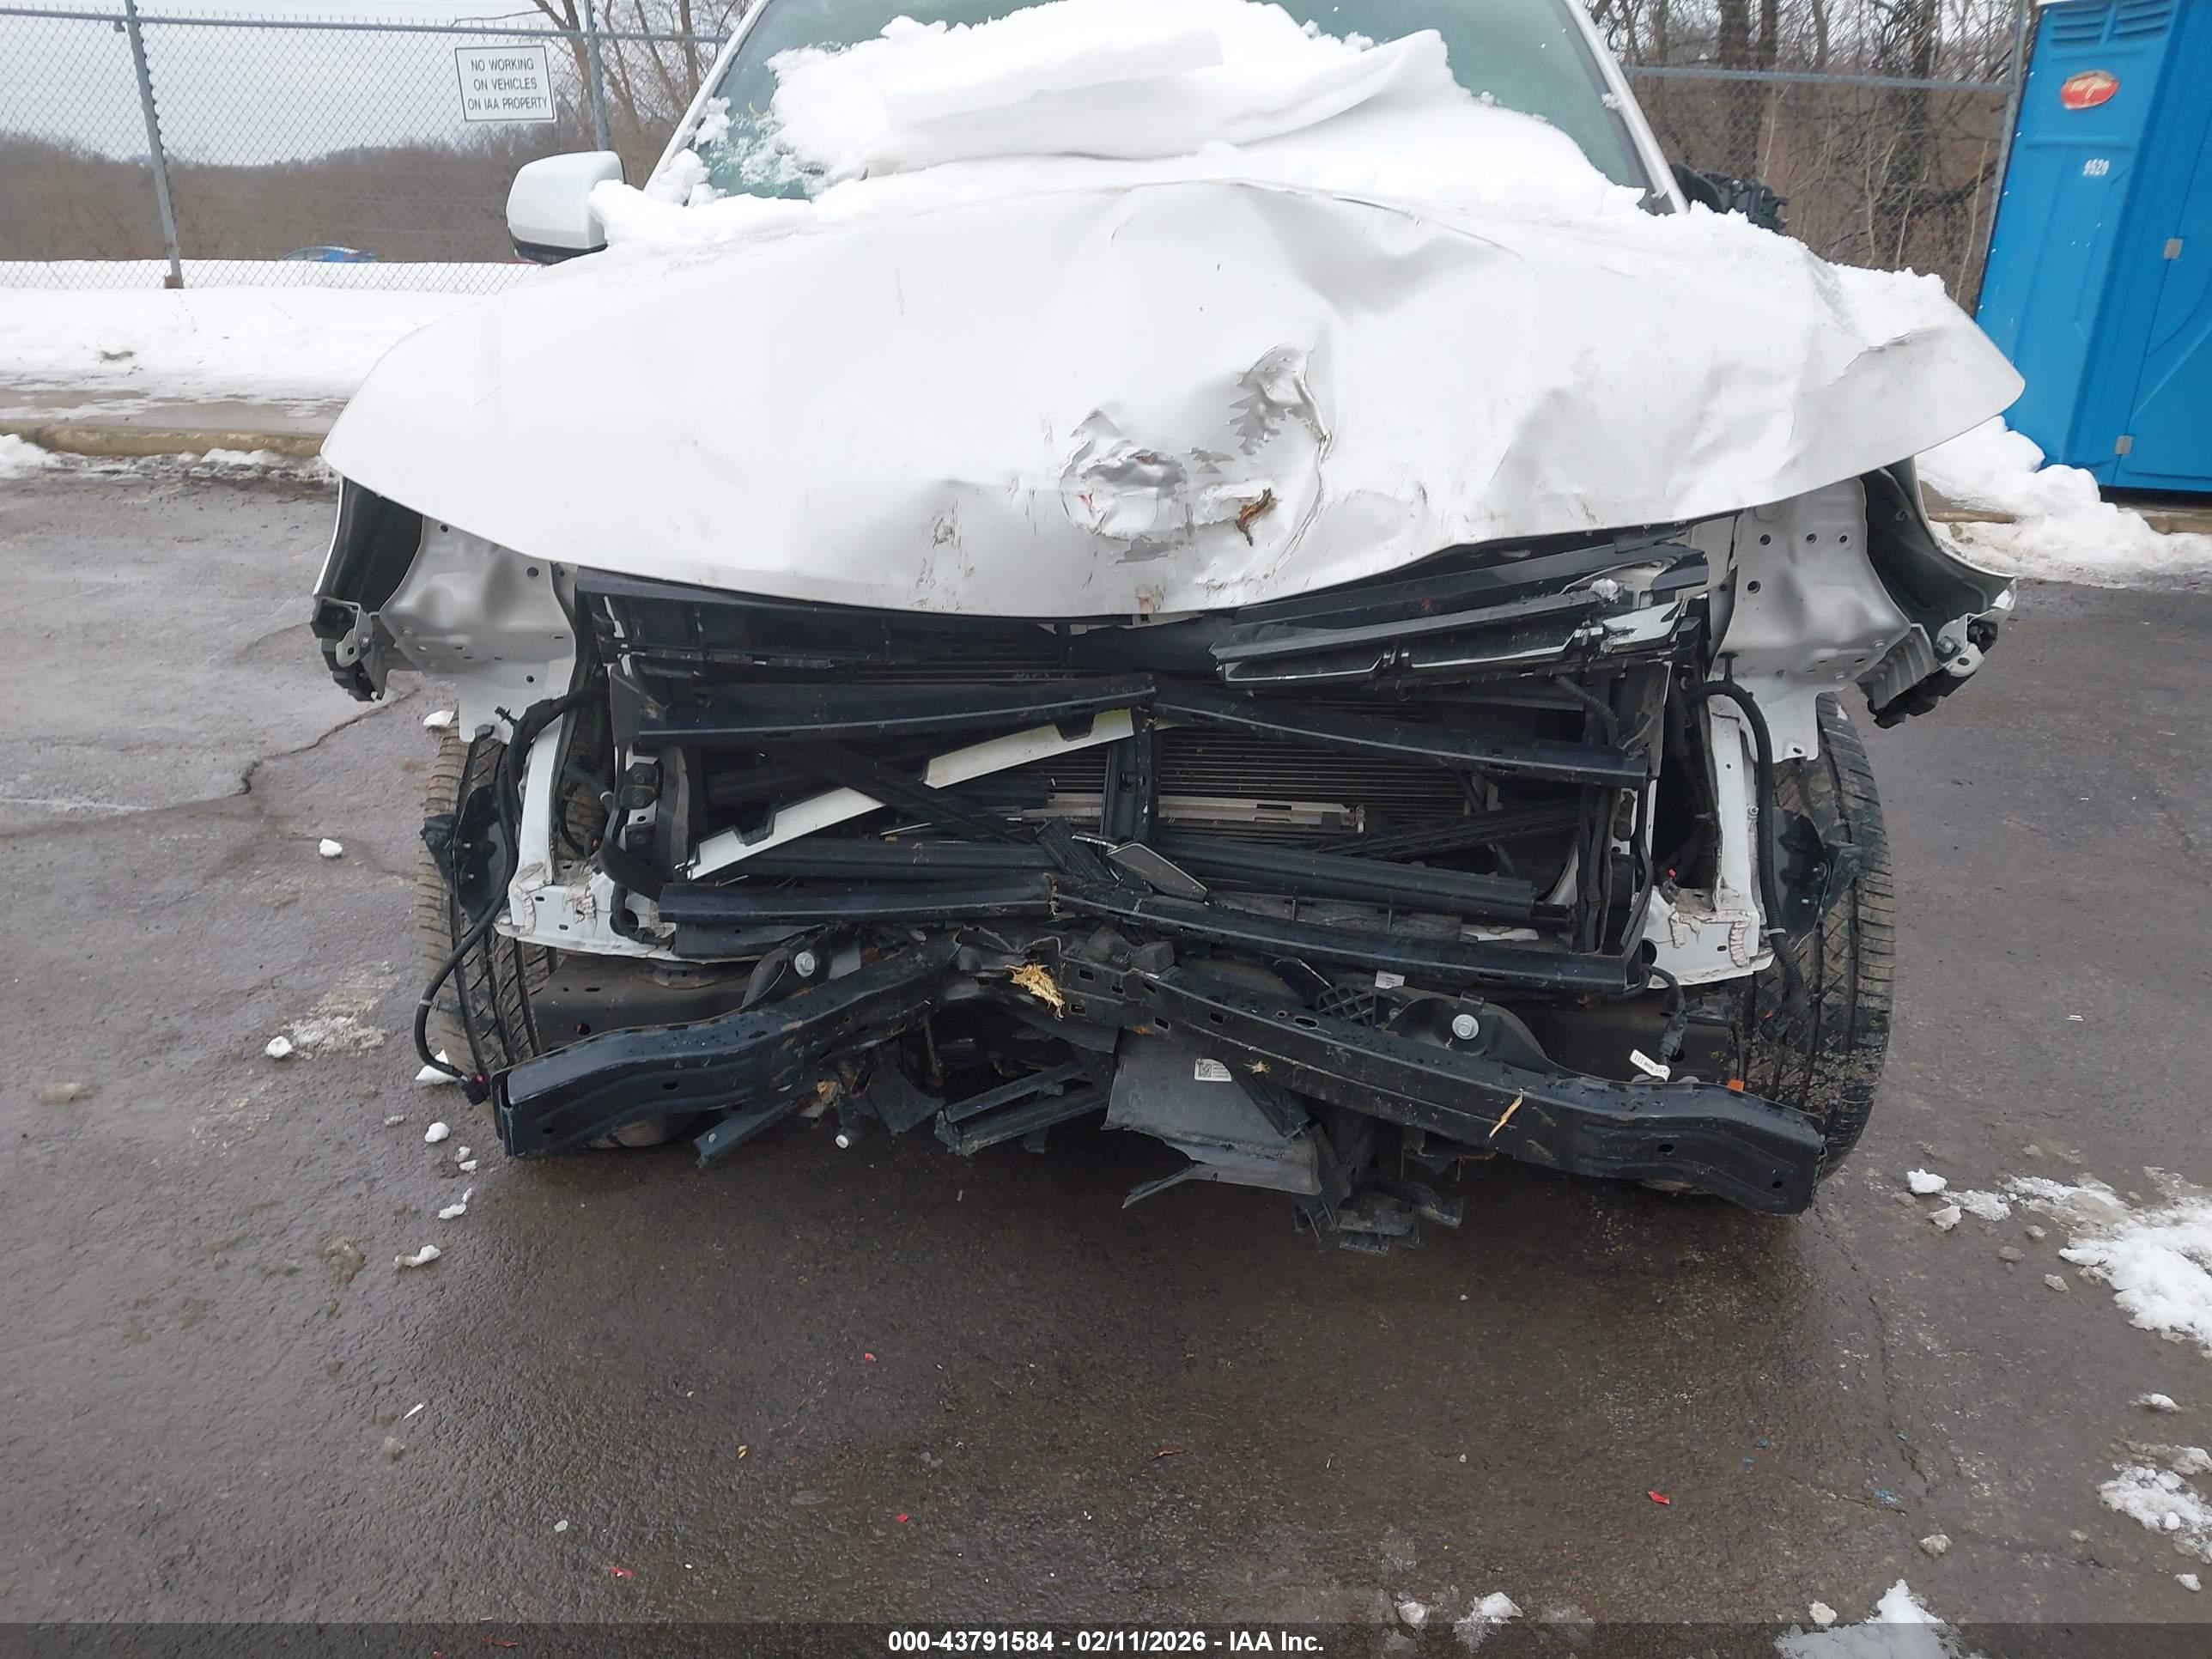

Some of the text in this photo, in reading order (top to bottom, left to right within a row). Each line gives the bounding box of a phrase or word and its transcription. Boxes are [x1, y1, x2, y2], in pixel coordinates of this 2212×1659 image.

[471, 57, 534, 71] NO WORKING
[473, 77, 538, 91] ON VEHICLES
[467, 96, 547, 111] ON IAA PROPERTY
